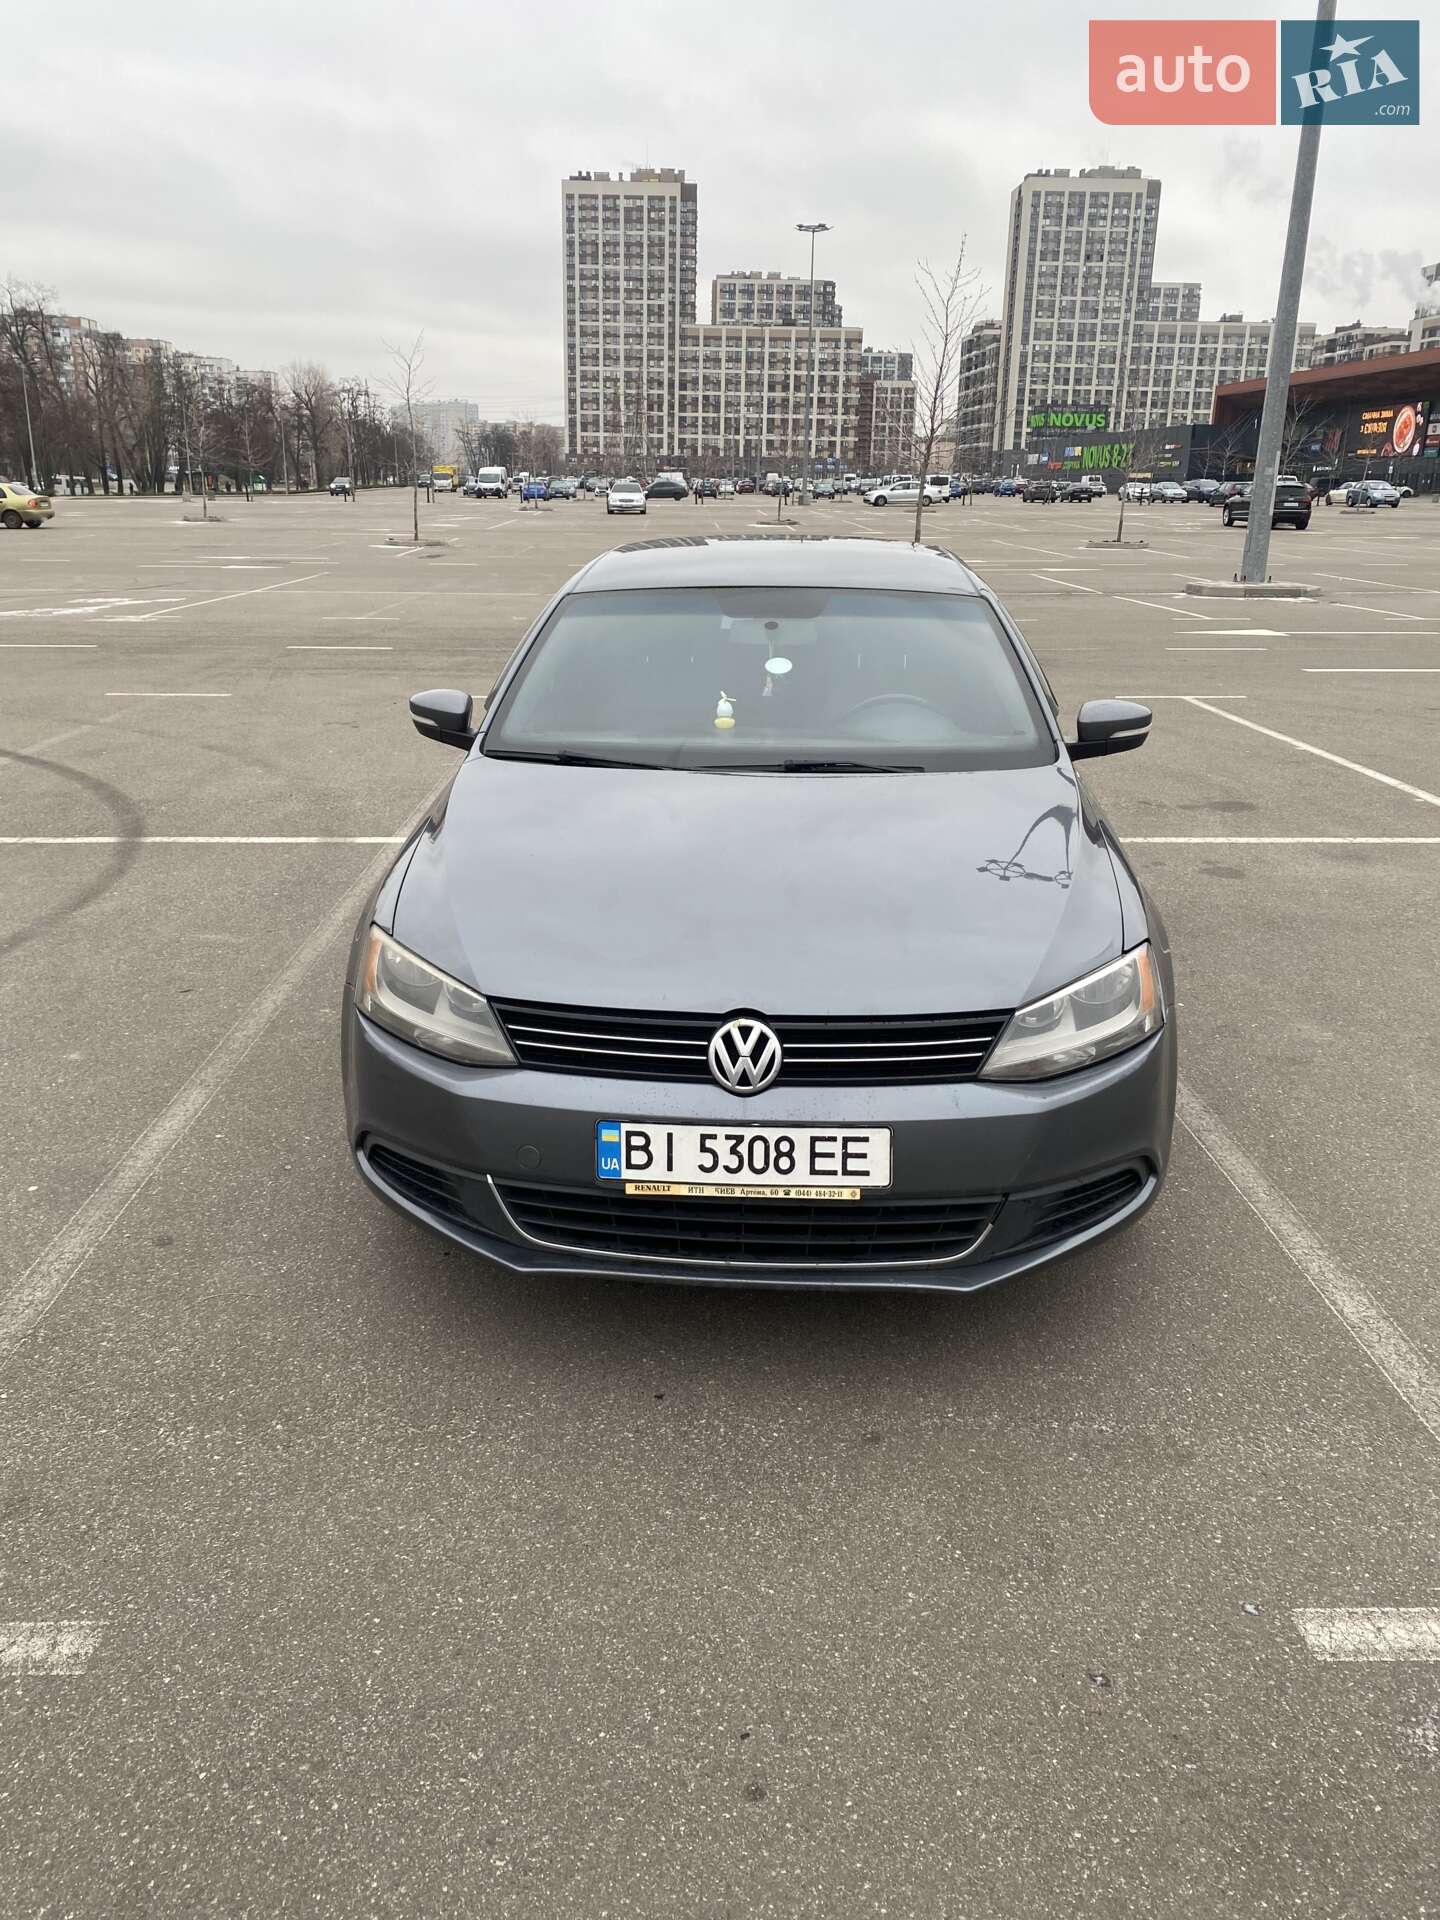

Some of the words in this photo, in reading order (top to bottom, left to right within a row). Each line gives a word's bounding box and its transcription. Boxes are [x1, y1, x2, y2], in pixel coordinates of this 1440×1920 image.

[1049, 412, 1106, 427] NOVUS
[1083, 444, 1111, 470] NOVUS
[697, 1133, 795, 1176] 5308
[809, 1135, 870, 1177] EE
[602, 1157, 620, 1170] UA
[634, 1184, 672, 1192] RENAULT
